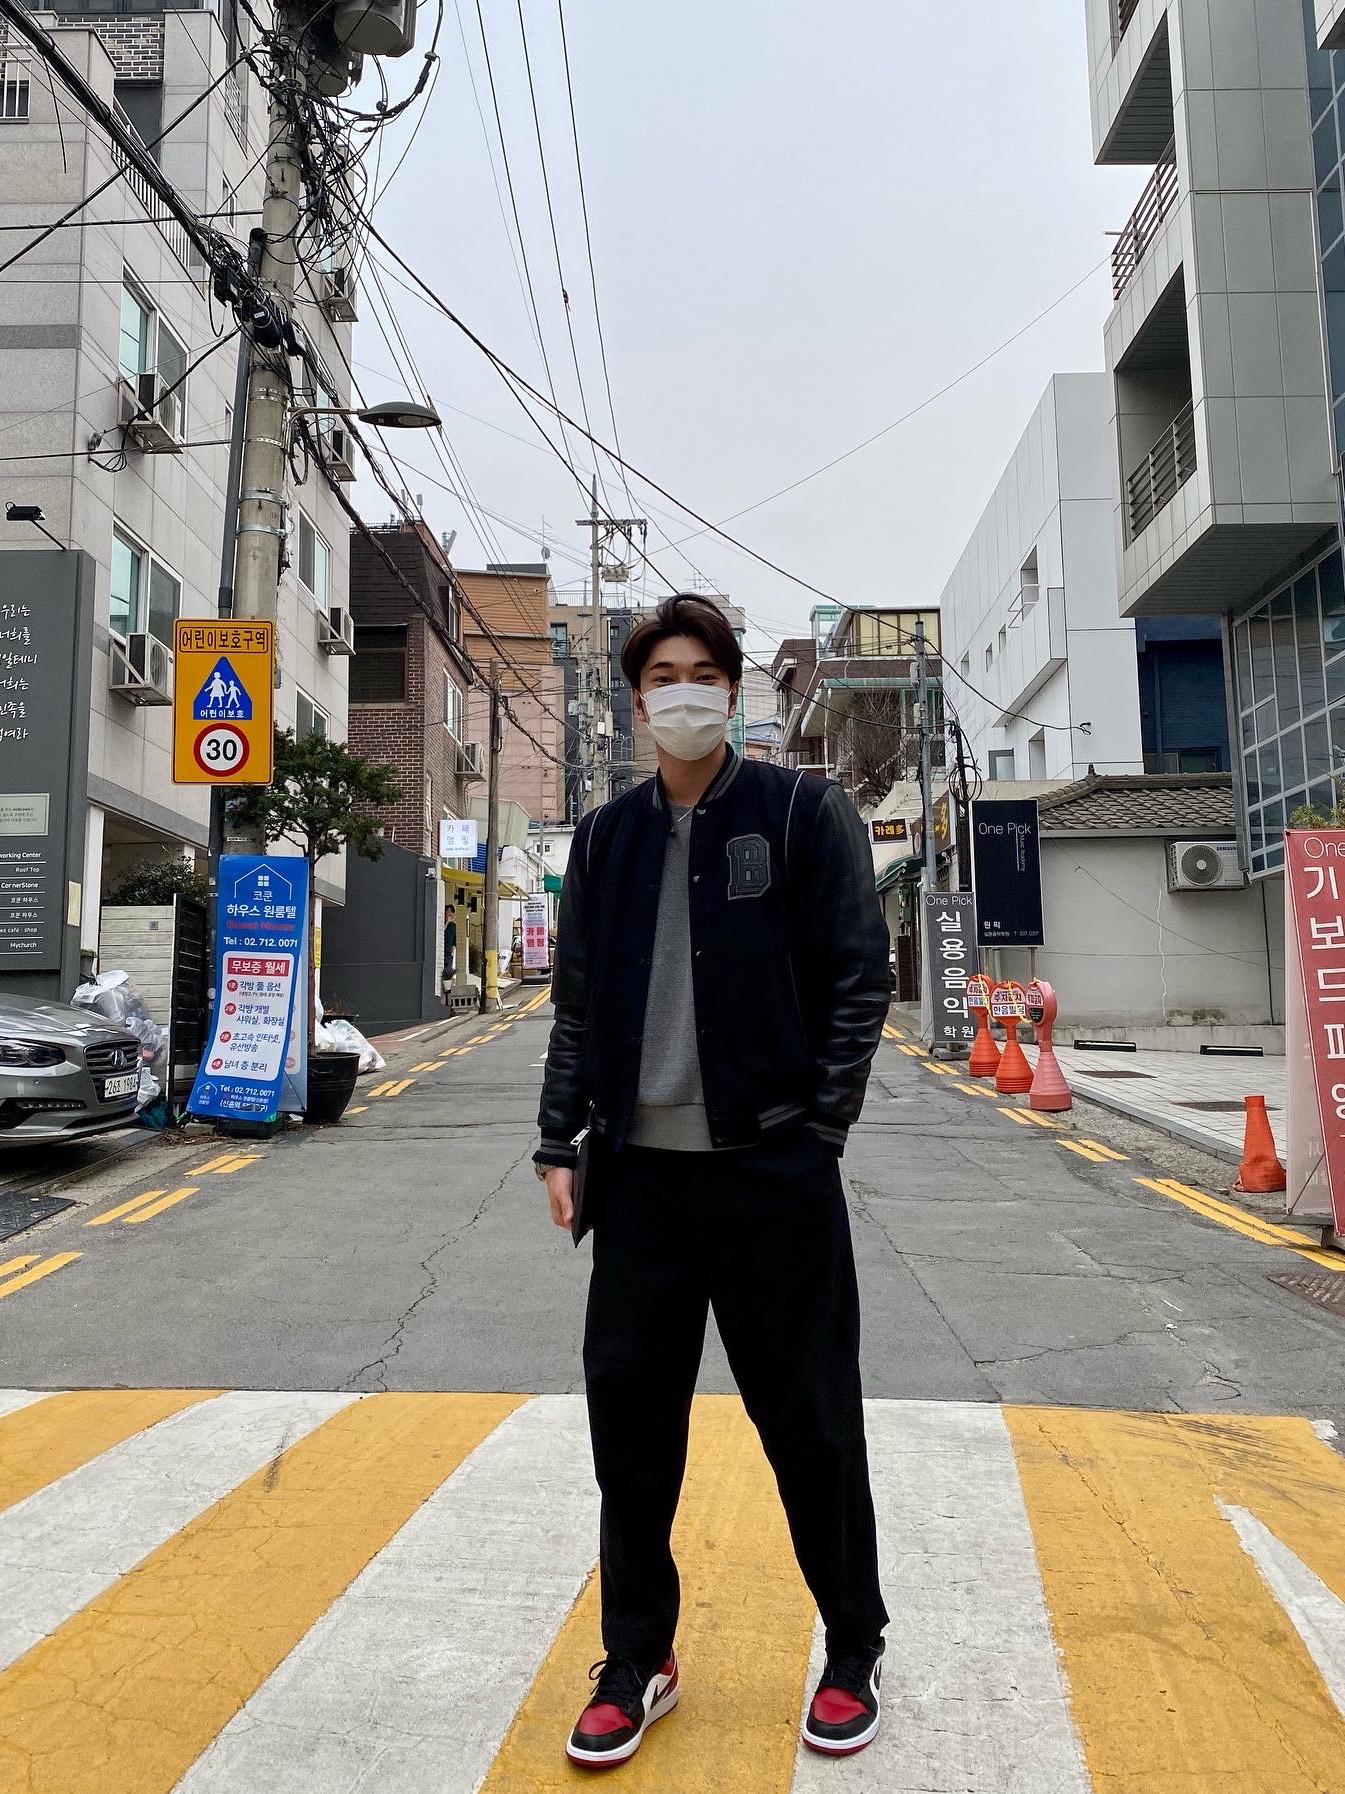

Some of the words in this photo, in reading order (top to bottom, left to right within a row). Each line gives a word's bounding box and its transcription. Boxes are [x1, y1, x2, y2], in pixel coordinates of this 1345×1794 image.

[1, 604, 31, 620] 우리는
[182, 629, 265, 650] 어린이보호구역
[200, 709, 244, 719] 어린이보호
[206, 738, 237, 761] 30
[979, 822, 1004, 835] One
[1007, 822, 1031, 835] Pick
[727, 833, 771, 900] B
[1, 881, 39, 889] CornerStone
[22, 896, 39, 904] 하우스
[253, 890, 273, 902] 코쿤
[925, 895, 948, 906] One
[952, 896, 973, 906] Pick
[22, 911, 38, 919] 하우스
[227, 904, 260, 917] 하우스
[263, 905, 296, 919] 원룸텔
[223, 937, 237, 945] Tel
[231, 960, 262, 974] 무보증
[265, 961, 286, 975] 월세
[935, 911, 970, 1019] 실용음악
[240, 981, 254, 991] 각방
[266, 982, 281, 992] 옵션
[238, 1004, 253, 1014] 각방
[263, 1016, 285, 1027] 화장실
[232, 1032, 254, 1042] 초고속
[229, 1043, 258, 1053] 유선방송
[224, 1060, 239, 1069] 남녀
[240, 1060, 249, 1071] 층
[251, 1061, 268, 1072] 분리
[220, 1084, 230, 1092] Tel
